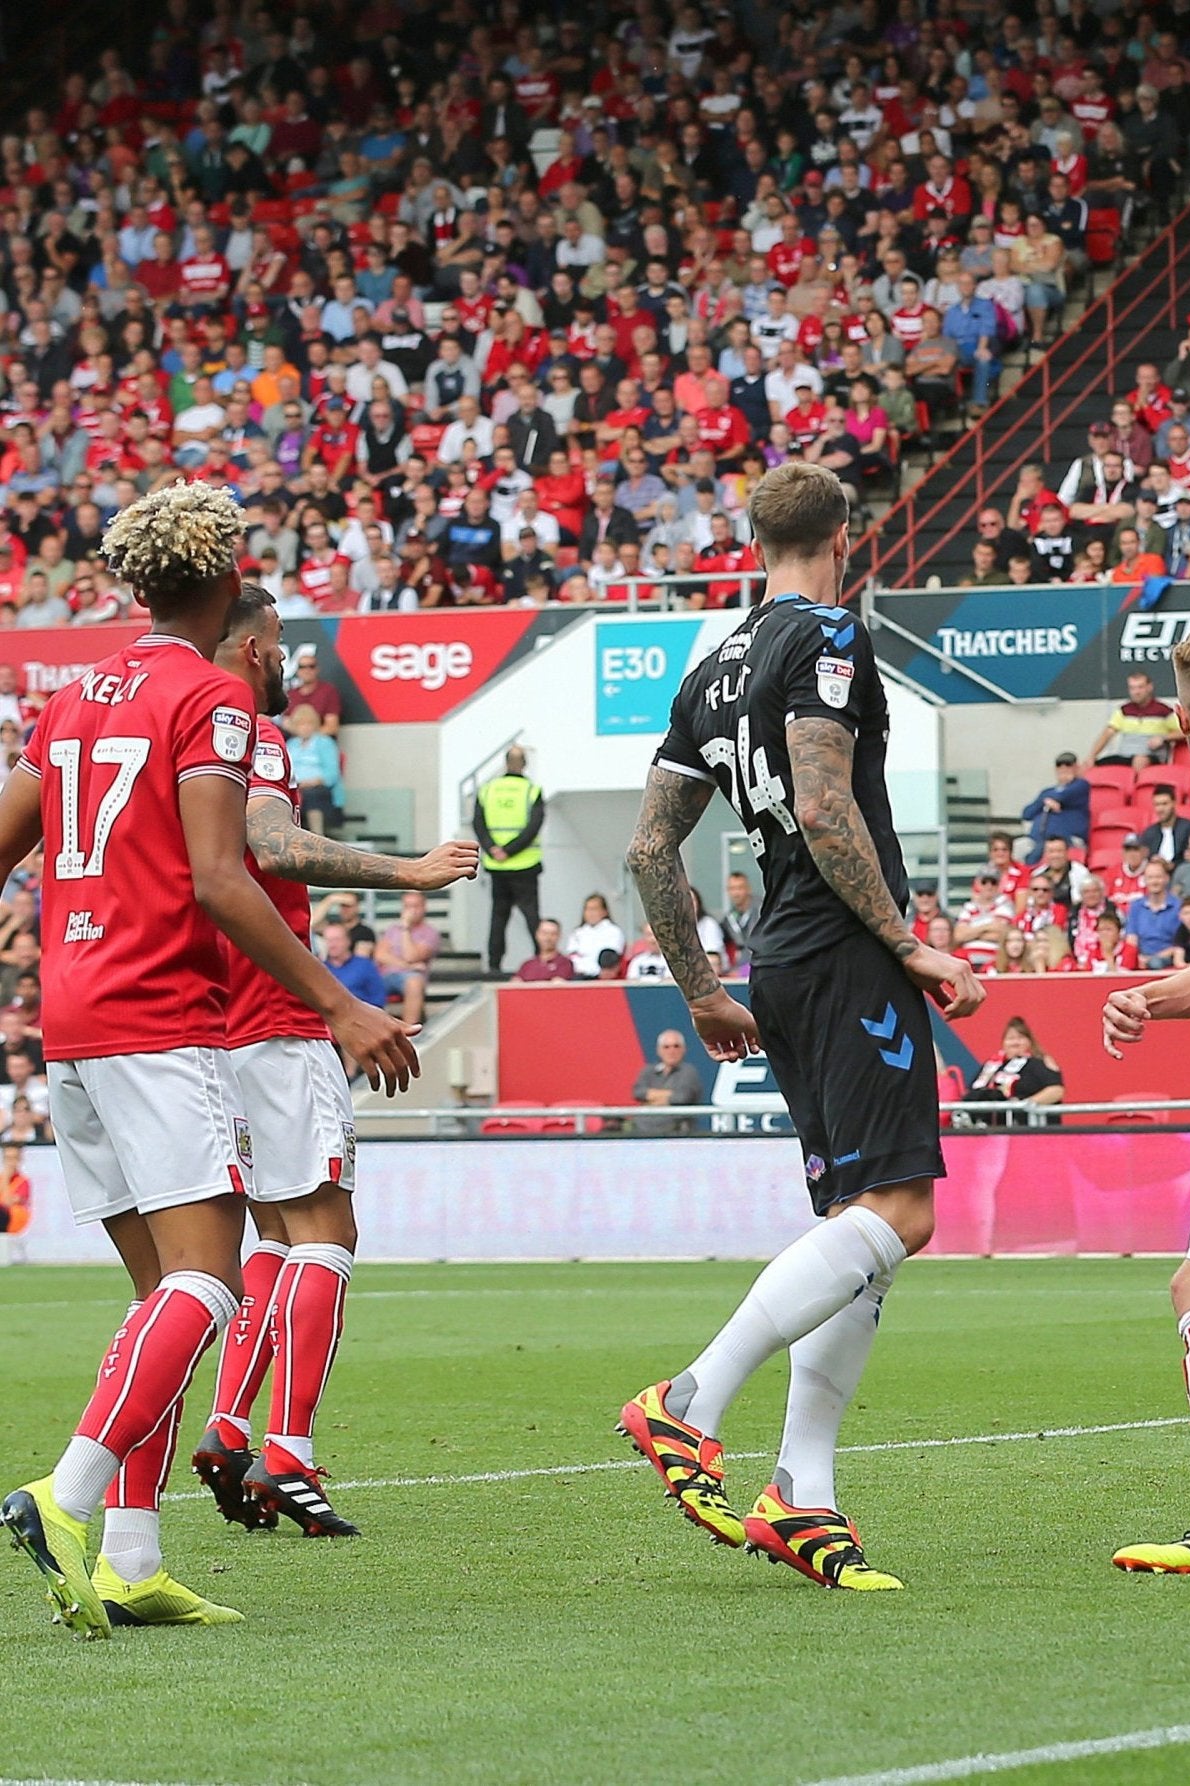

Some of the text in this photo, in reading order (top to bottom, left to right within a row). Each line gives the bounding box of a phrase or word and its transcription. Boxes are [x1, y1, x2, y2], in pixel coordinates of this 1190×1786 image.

[370, 640, 473, 690] sage
[602, 645, 667, 681] E30
[936, 624, 1078, 658] THATCHERS
[836, 664, 854, 677] bet
[49, 737, 151, 880] 17
[698, 713, 798, 858] 24
[833, 1149, 861, 1166] hummel
[235, 1296, 255, 1345] CITY
[267, 1303, 282, 1358] CITY
[104, 1327, 128, 1379] CITY
